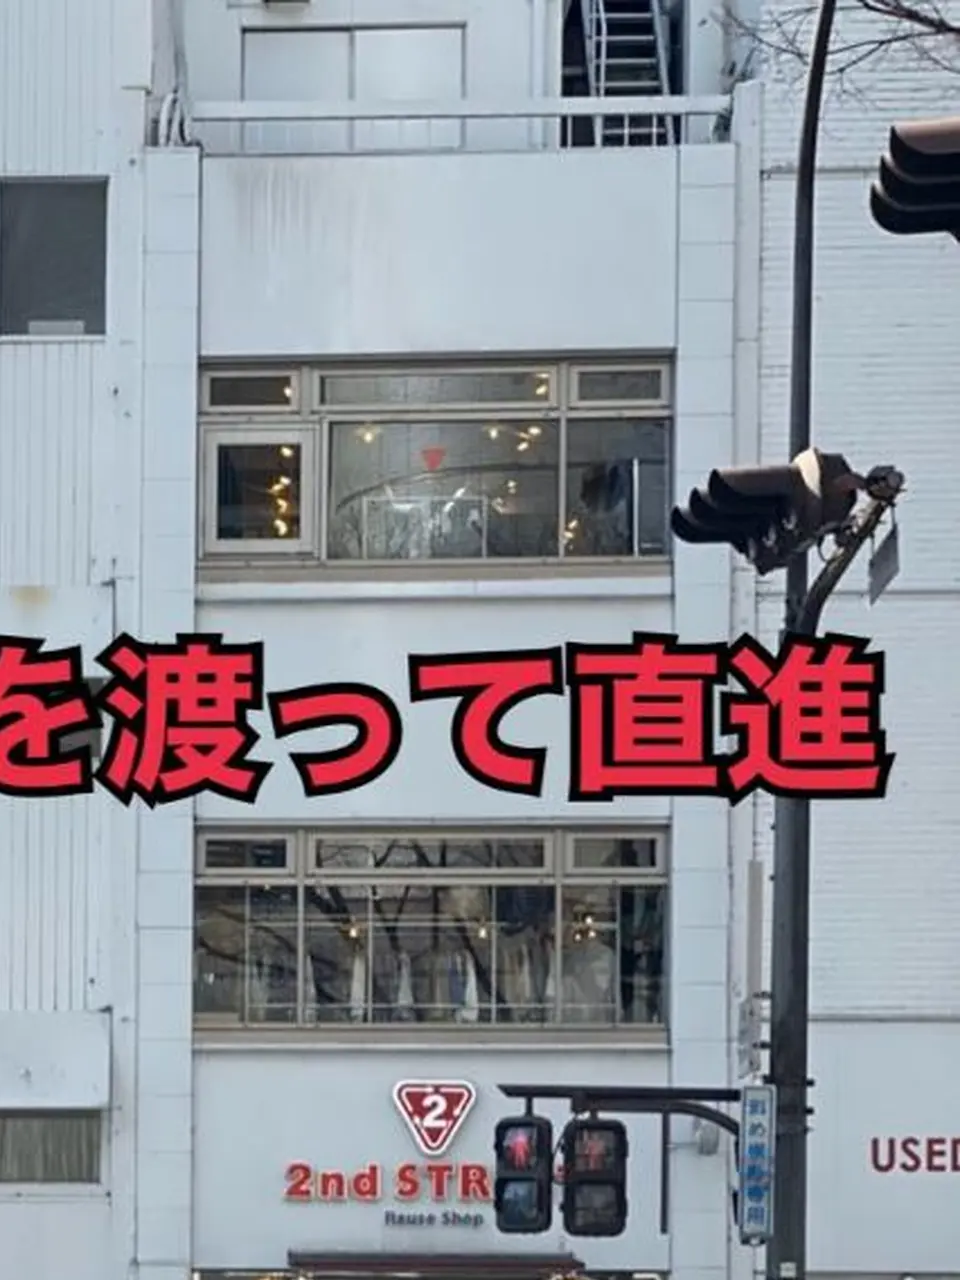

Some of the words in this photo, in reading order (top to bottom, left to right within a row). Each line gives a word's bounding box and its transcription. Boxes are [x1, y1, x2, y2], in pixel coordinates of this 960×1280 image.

[422, 1095, 448, 1128] 2
[285, 1163, 381, 1199] 2nd
[396, 1163, 491, 1200] STR
[442, 1209, 485, 1229] Shop
